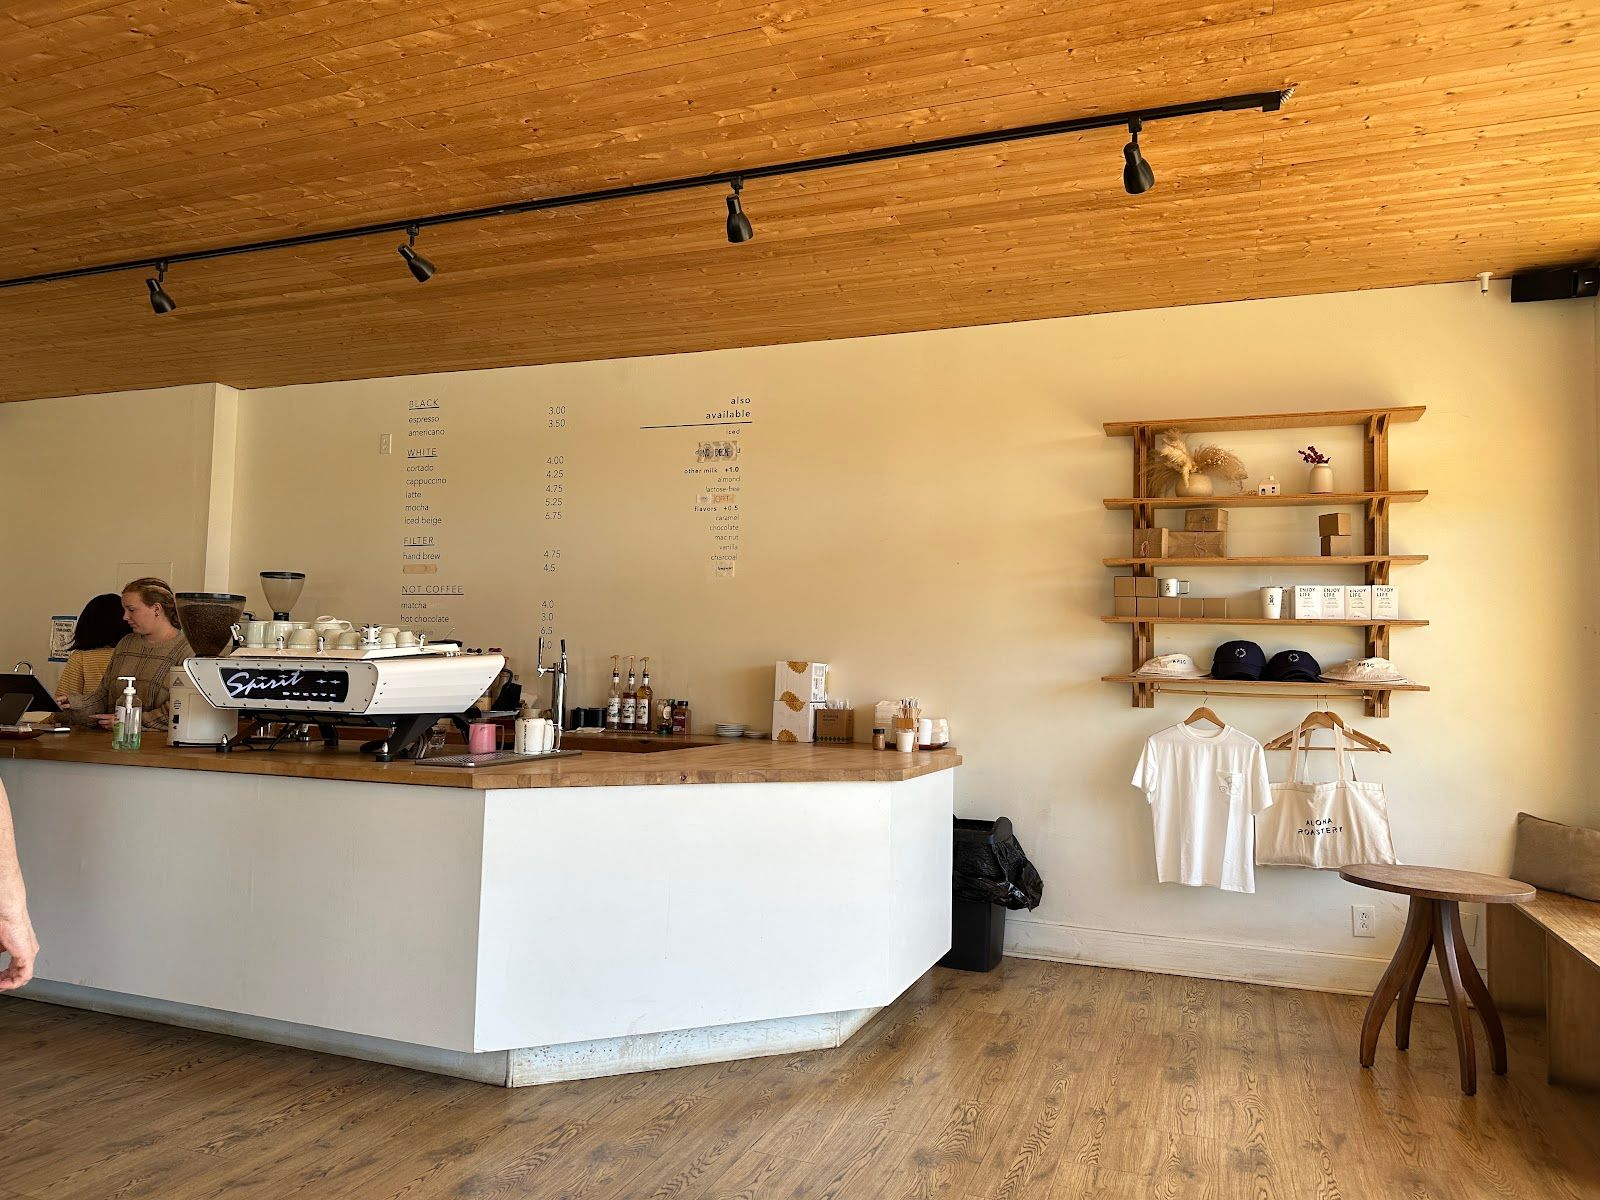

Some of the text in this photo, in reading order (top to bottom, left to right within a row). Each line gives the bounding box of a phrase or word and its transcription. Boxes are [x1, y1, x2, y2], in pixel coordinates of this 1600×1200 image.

[409, 398, 439, 408] BLACK
[731, 396, 751, 404] also
[548, 406, 566, 415] 3.00
[706, 410, 751, 419] available
[408, 415, 439, 424] espresso
[548, 419, 566, 428] 3.50
[408, 428, 445, 436] americano
[407, 448, 437, 457] WHITE
[546, 456, 564, 465] 4.00
[406, 464, 434, 472] cortado
[546, 470, 564, 478] 4.25
[406, 477, 447, 486] cappuccino
[545, 485, 563, 493] 4.75
[545, 498, 562, 506] 5.25
[545, 512, 562, 520] 6.75
[421, 516, 442, 526] beige
[404, 537, 434, 545] FILTER
[403, 552, 441, 560] hand brew
[543, 550, 561, 558] 4.75
[543, 564, 556, 572] 4.5
[401, 585, 463, 594] NOT COFFEE
[401, 601, 427, 609] matcha
[541, 600, 554, 608] 4.0
[400, 614, 449, 623] hot chocolate
[541, 613, 554, 621] 3.0
[540, 626, 553, 635] 6.5
[226, 670, 304, 697] Spirit
[1306, 818, 1332, 826] ALOHA
[1298, 826, 1343, 835] ROASTERY
